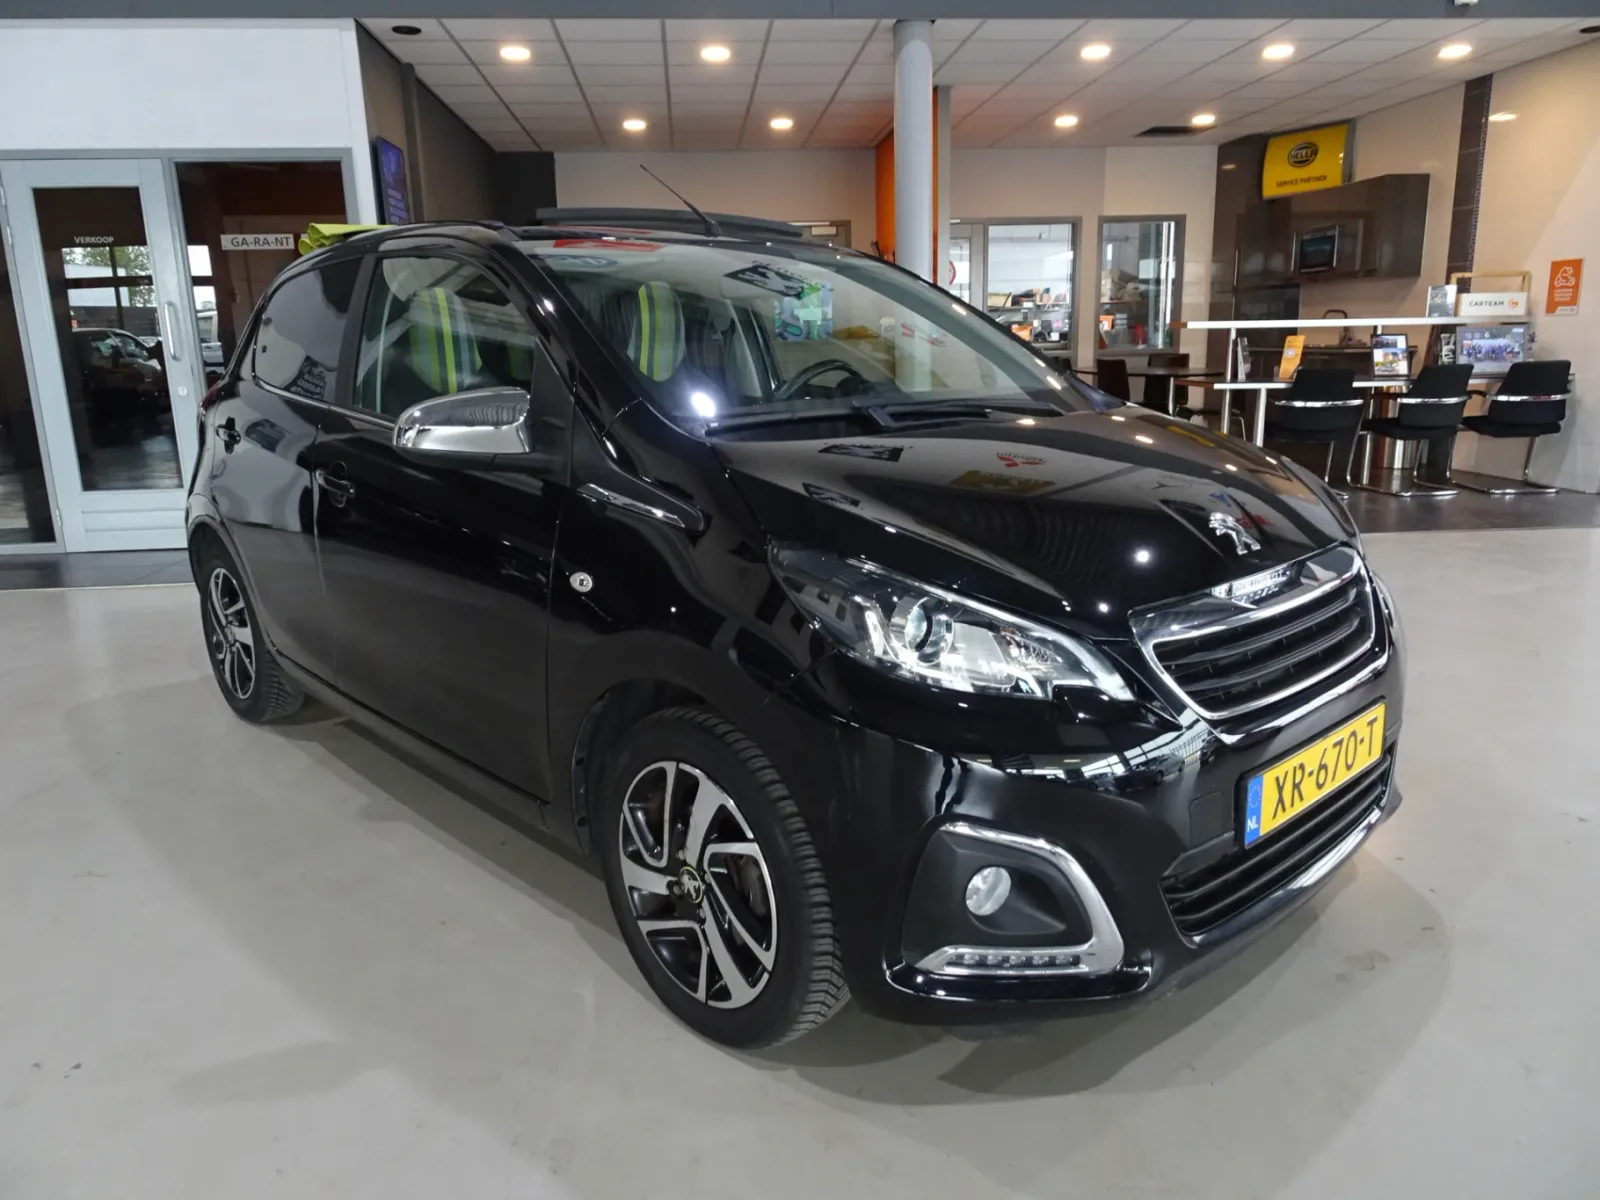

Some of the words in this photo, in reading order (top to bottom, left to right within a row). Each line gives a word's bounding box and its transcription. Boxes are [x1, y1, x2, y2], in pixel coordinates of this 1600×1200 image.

[1290, 148, 1317, 160] HELLA
[1300, 174, 1327, 184] PARTNER
[231, 236, 290, 247] GA-RA-NT
[1272, 715, 1378, 820] XR-670-T
[1247, 816, 1258, 832] NL
